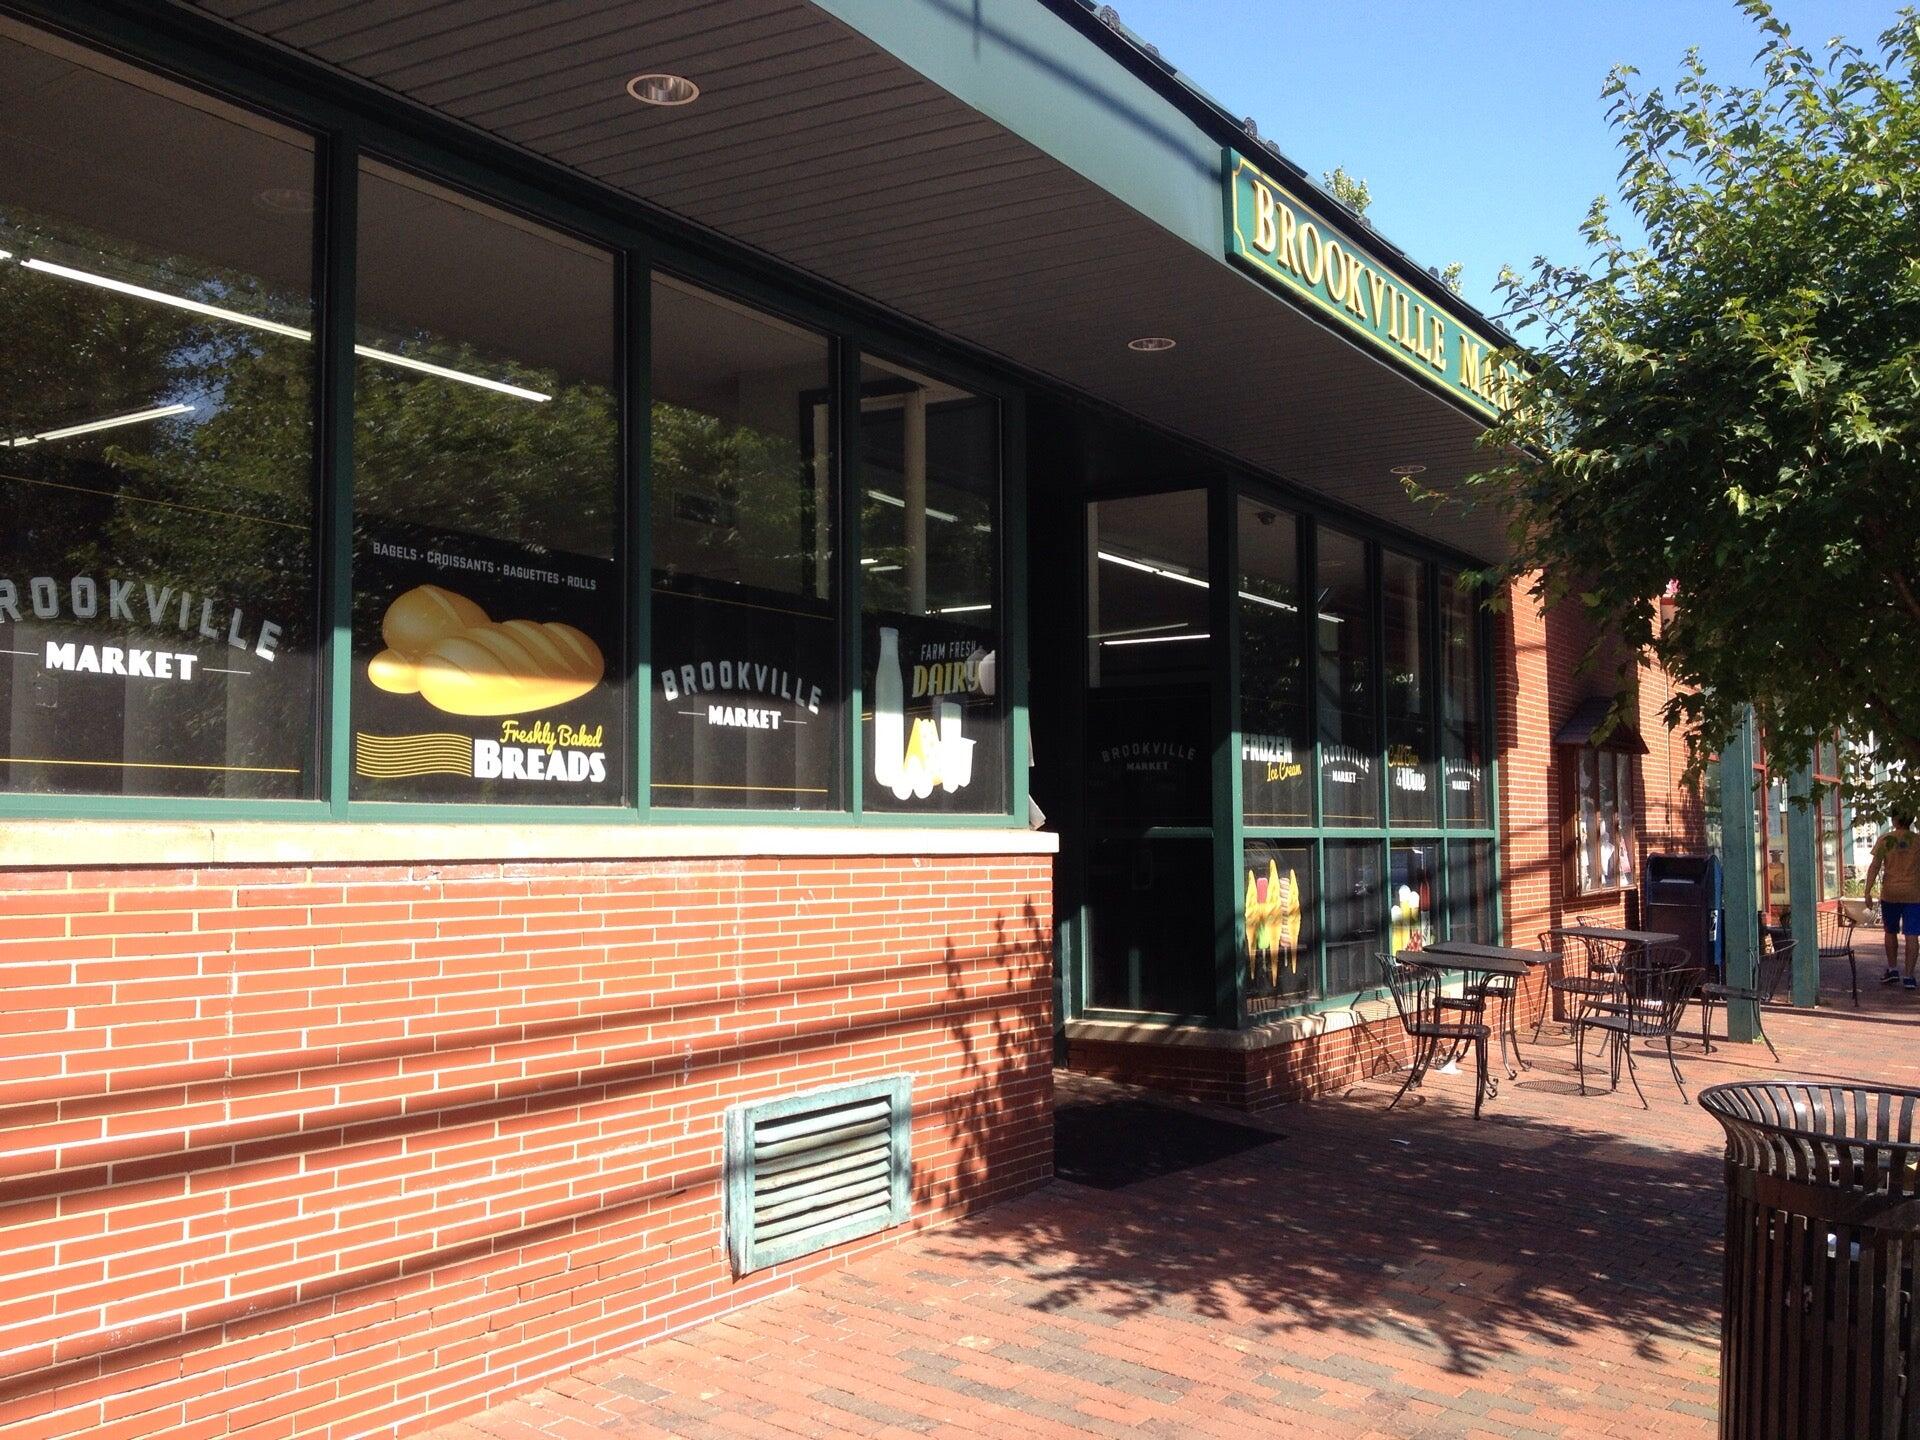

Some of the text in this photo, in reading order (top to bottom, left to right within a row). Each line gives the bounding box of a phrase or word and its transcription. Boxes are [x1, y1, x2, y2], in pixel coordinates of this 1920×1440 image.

[1252, 179, 1447, 372] BROOKVILLE
[373, 541, 597, 591] BAGELS CROISSANTS BAGUETTES ROLLS
[0, 576, 283, 662] ROOKVILLE
[46, 641, 198, 681] MARKET
[921, 640, 977, 661] FARM FRESH
[661, 660, 822, 715] BROOKVILLE
[912, 660, 980, 698] DAIRY
[708, 705, 782, 730] MARKET
[500, 720, 603, 755] Freshly Baked
[1100, 741, 1196, 762] BROOKVILLE
[1242, 733, 1292, 763] FROZEN
[474, 739, 606, 783] BREADS
[1126, 761, 1168, 771] MARKET
[1266, 760, 1303, 782] Ice Cream
[1332, 770, 1356, 783] MARKET
[1446, 757, 1480, 782] ROOKVILLE
